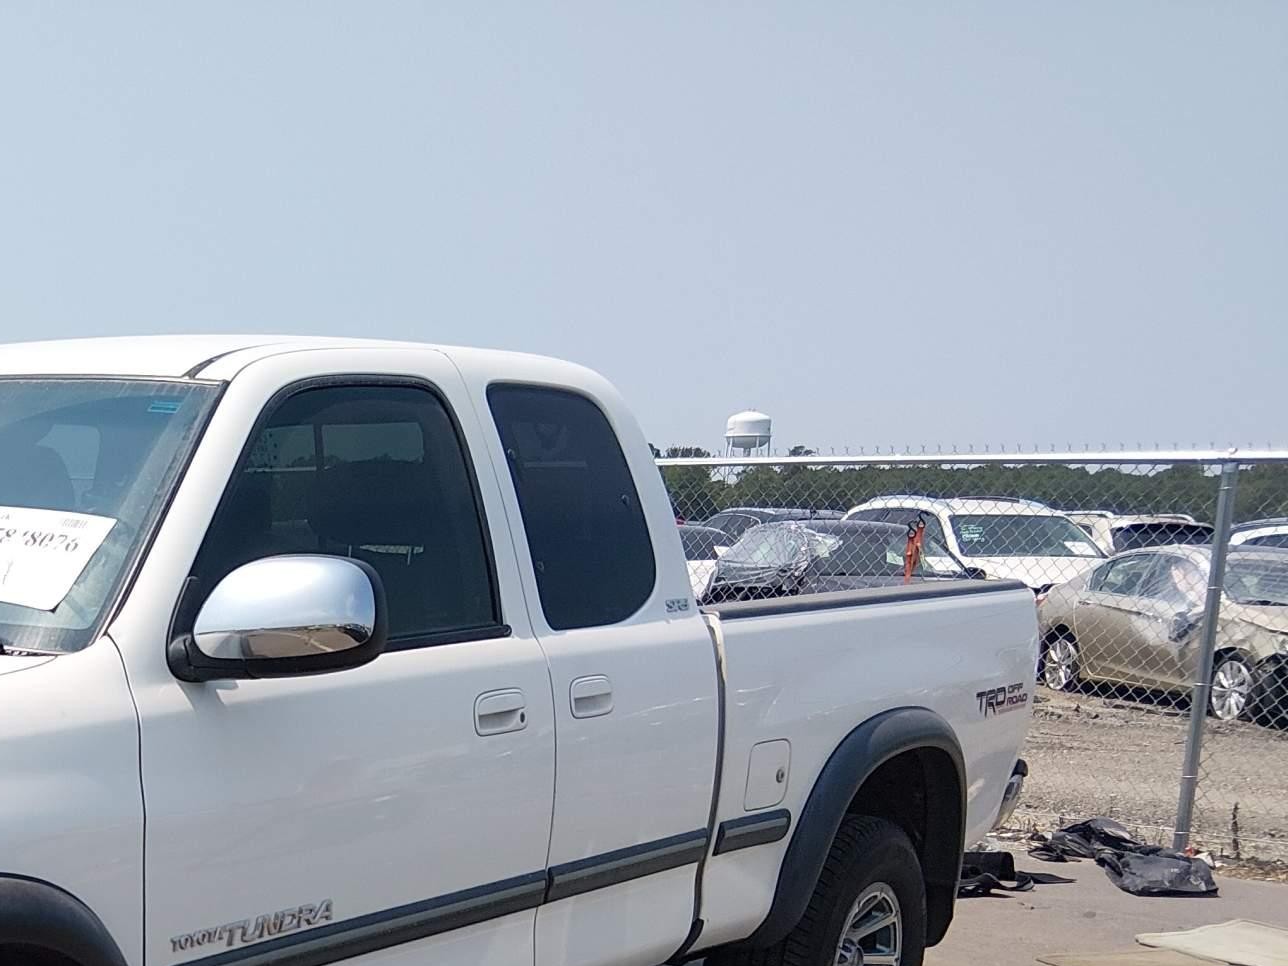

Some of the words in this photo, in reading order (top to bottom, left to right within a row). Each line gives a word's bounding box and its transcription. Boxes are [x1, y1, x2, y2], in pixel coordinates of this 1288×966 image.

[976, 686, 1007, 718] TRD
[1006, 692, 1028, 706] ROAD
[219, 898, 334, 948] TUNDRA
